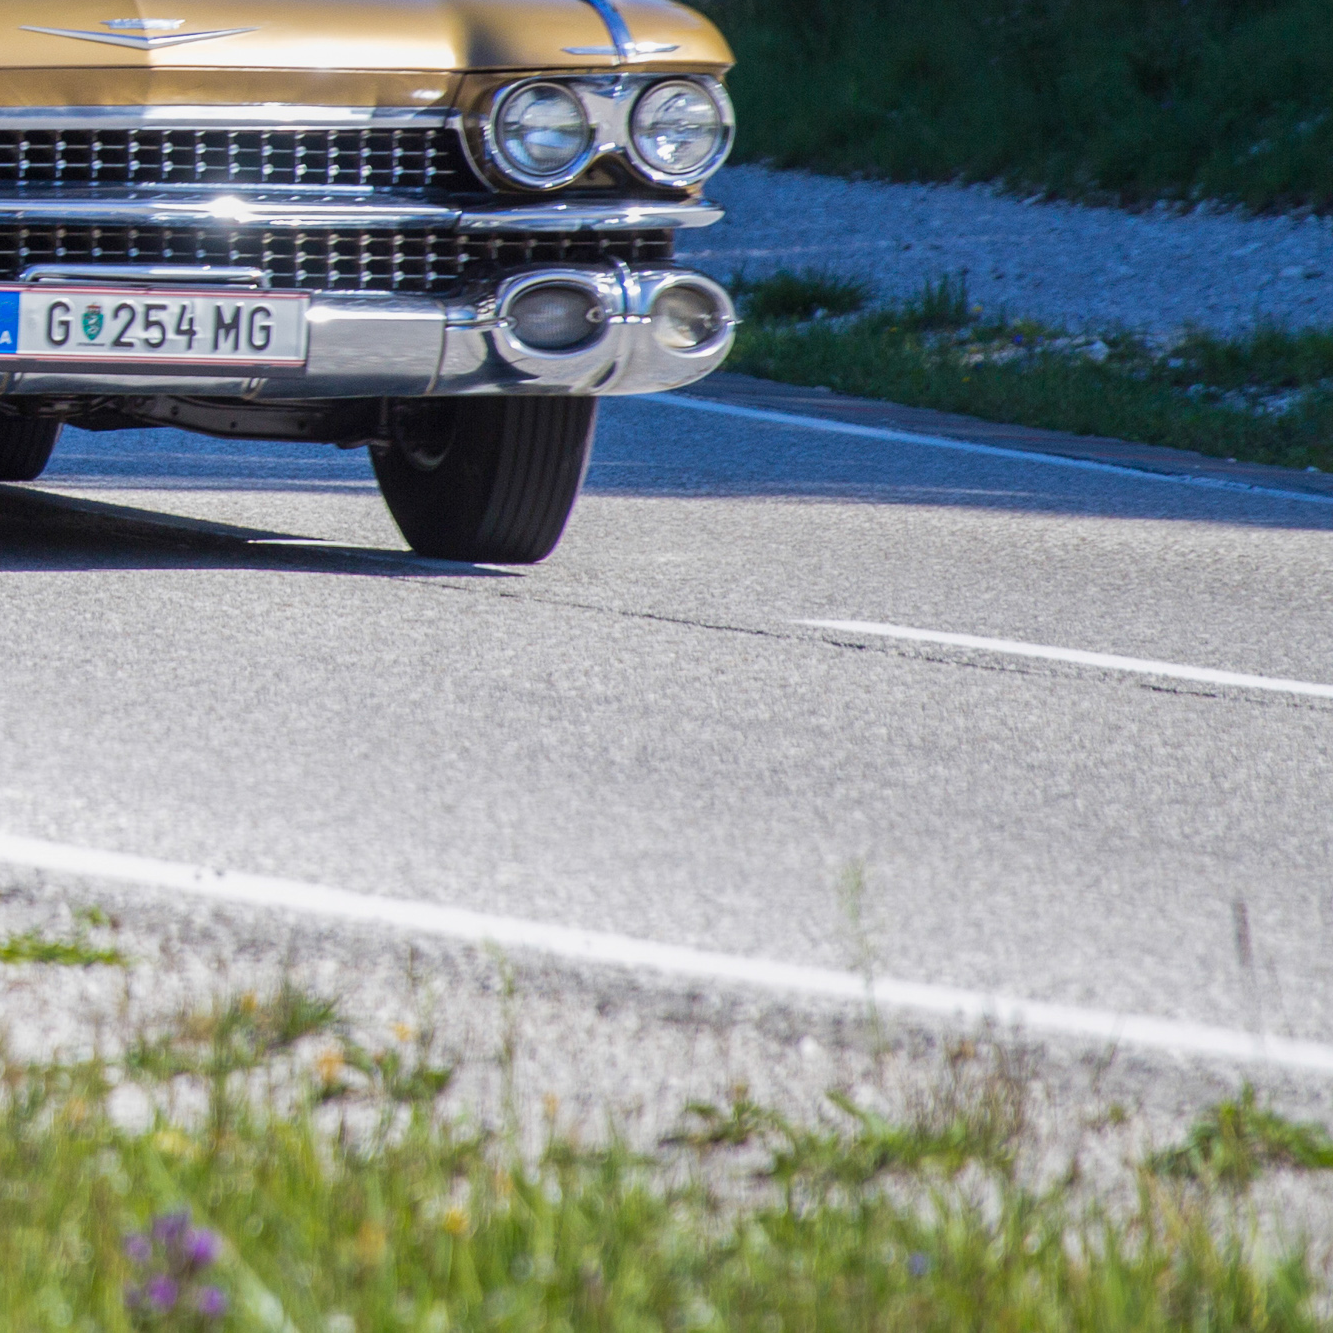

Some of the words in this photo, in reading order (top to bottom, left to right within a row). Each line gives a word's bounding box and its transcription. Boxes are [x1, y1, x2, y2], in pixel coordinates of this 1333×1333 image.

[47, 300, 72, 346] G
[111, 302, 198, 350] 254
[213, 304, 273, 352] MG
